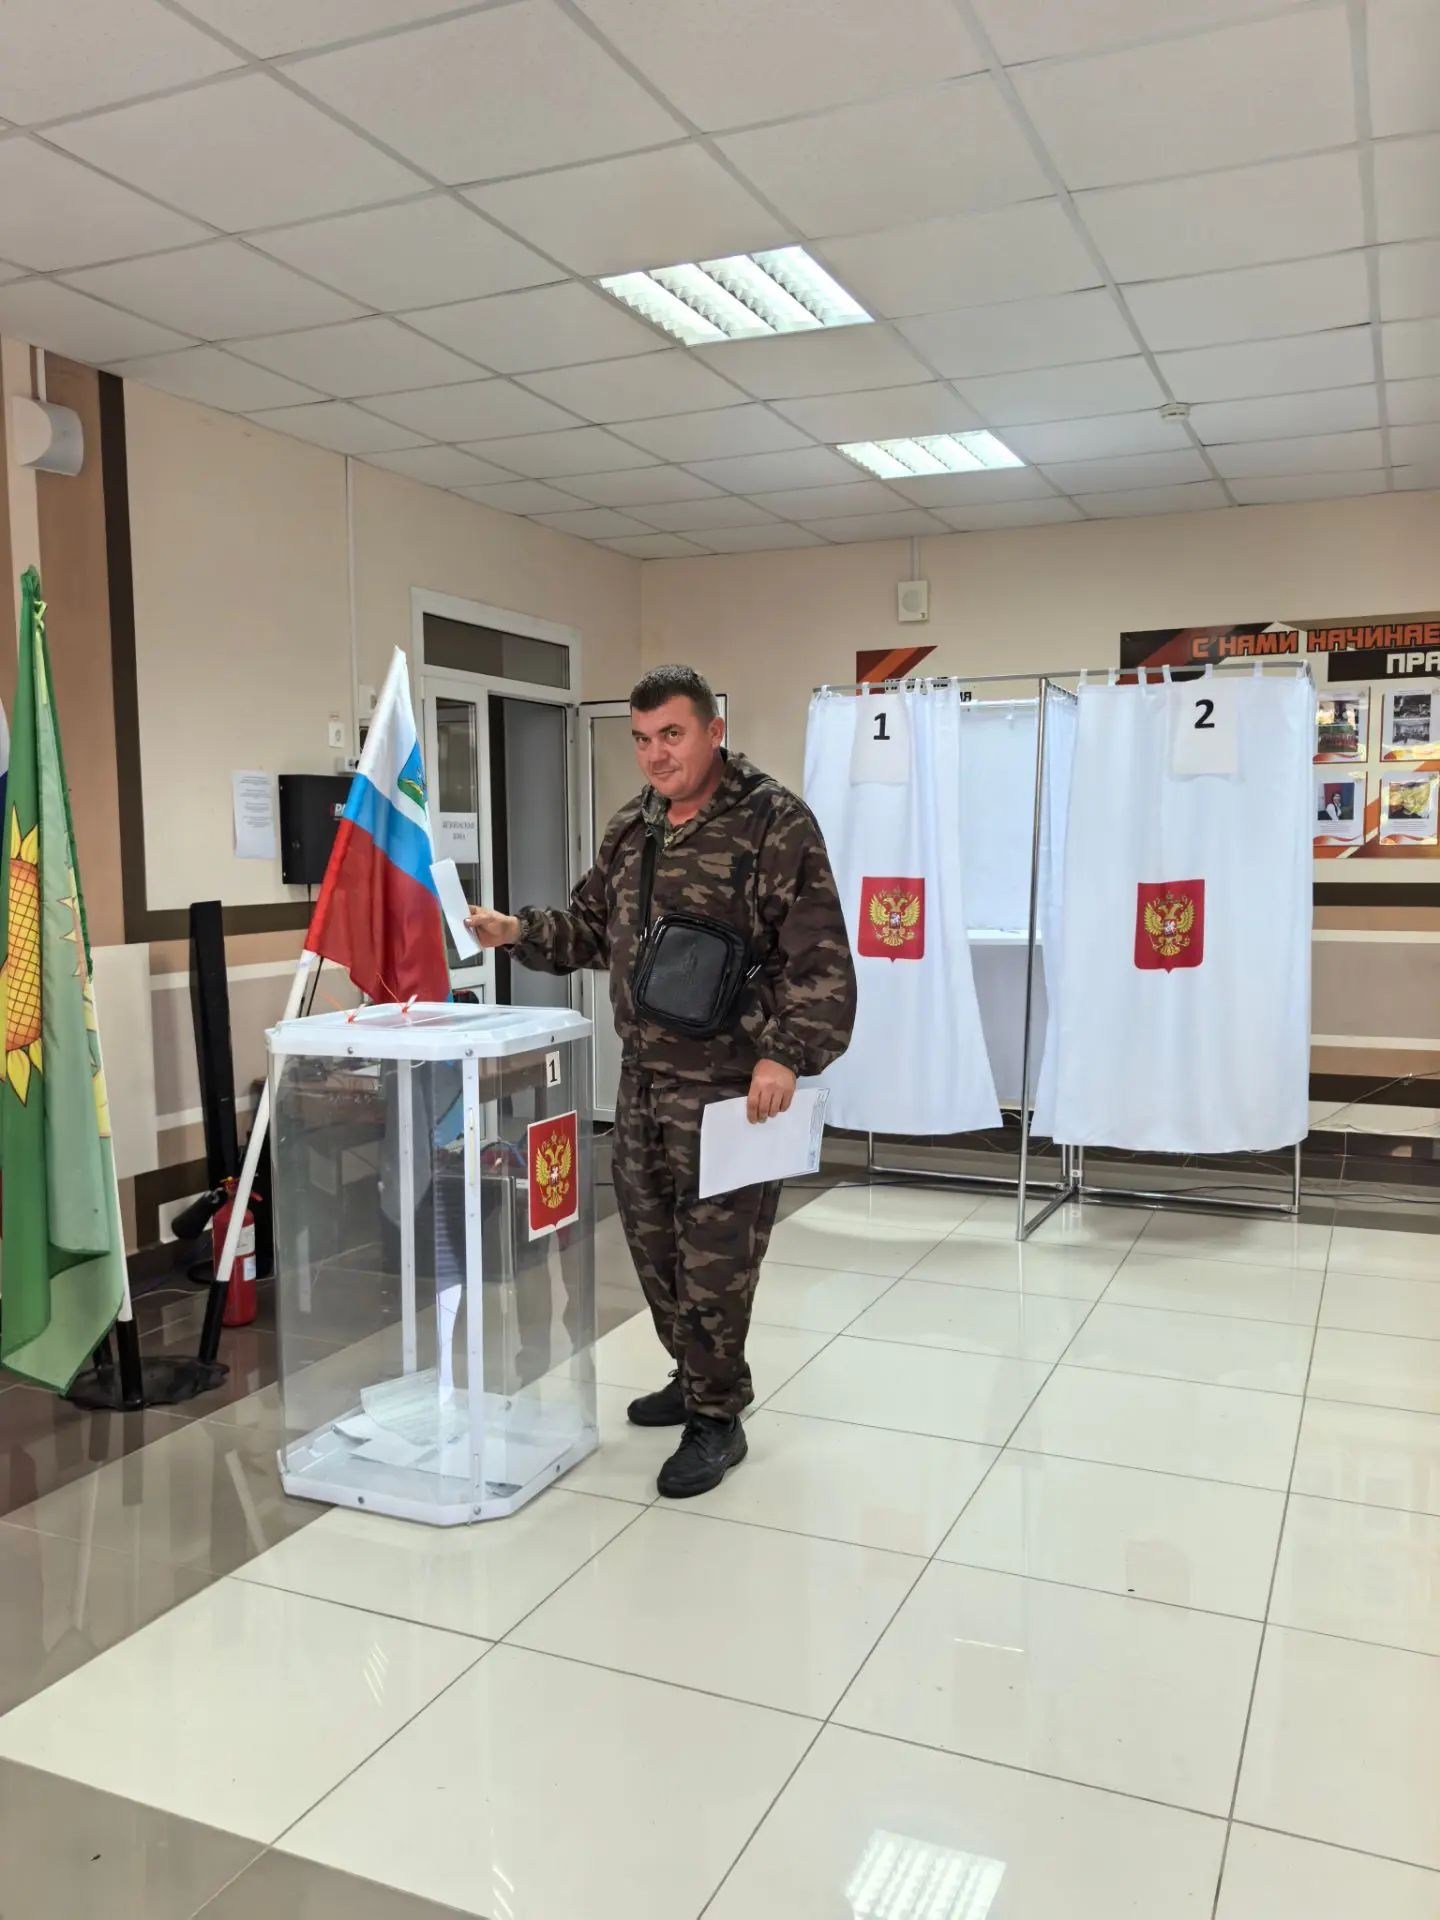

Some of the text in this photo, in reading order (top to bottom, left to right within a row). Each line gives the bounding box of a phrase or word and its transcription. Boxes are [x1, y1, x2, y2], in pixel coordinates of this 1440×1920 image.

[1192, 621, 1440, 658] С НАМИ НАЧИНАЕ
[1386, 650, 1440, 674] ПРА
[873, 712, 890, 741] 1
[1194, 699, 1215, 729] 2
[549, 1058, 558, 1083] 1
